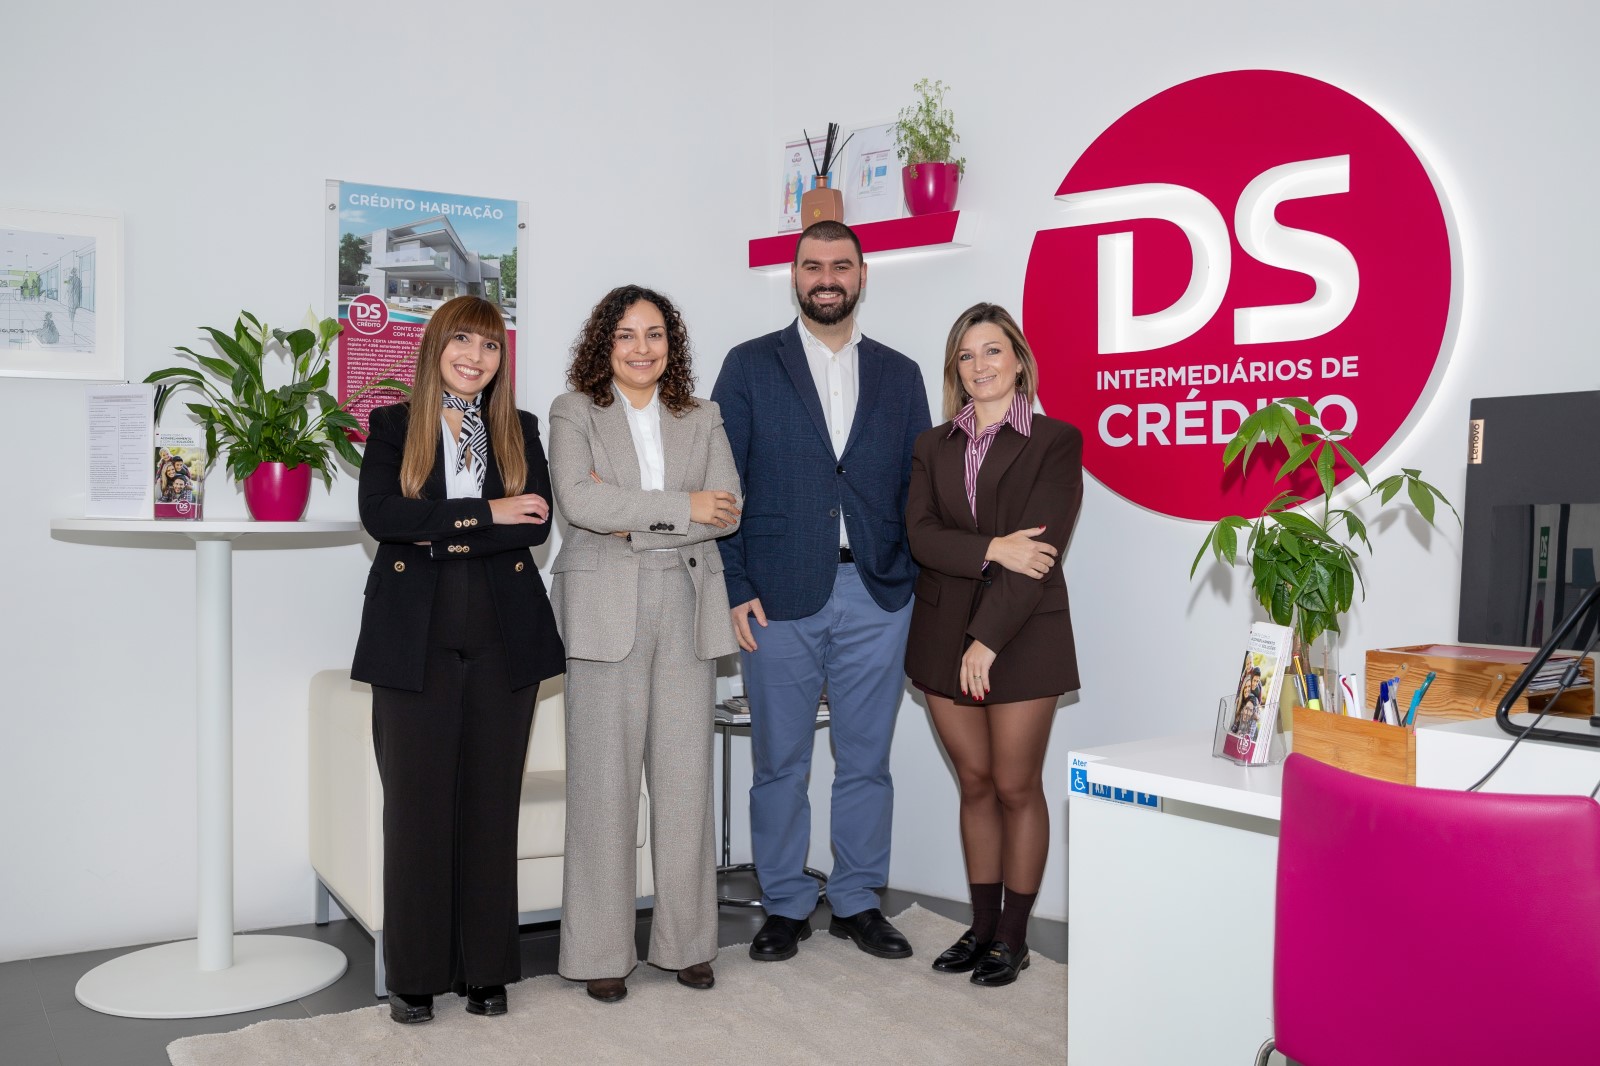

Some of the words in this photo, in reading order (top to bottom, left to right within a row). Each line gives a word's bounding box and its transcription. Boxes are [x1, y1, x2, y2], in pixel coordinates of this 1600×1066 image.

[348, 193, 415, 211] CRÉDITO
[420, 201, 504, 220] HABITAÇÃO
[1038, 154, 1360, 355] DS
[351, 302, 381, 319] DS
[1096, 356, 1312, 391] INTERMEDIÁRIOS
[1321, 355, 1359, 379] DE
[1097, 388, 1359, 448] CRÉDO
[1470, 424, 1480, 460] Lenovo
